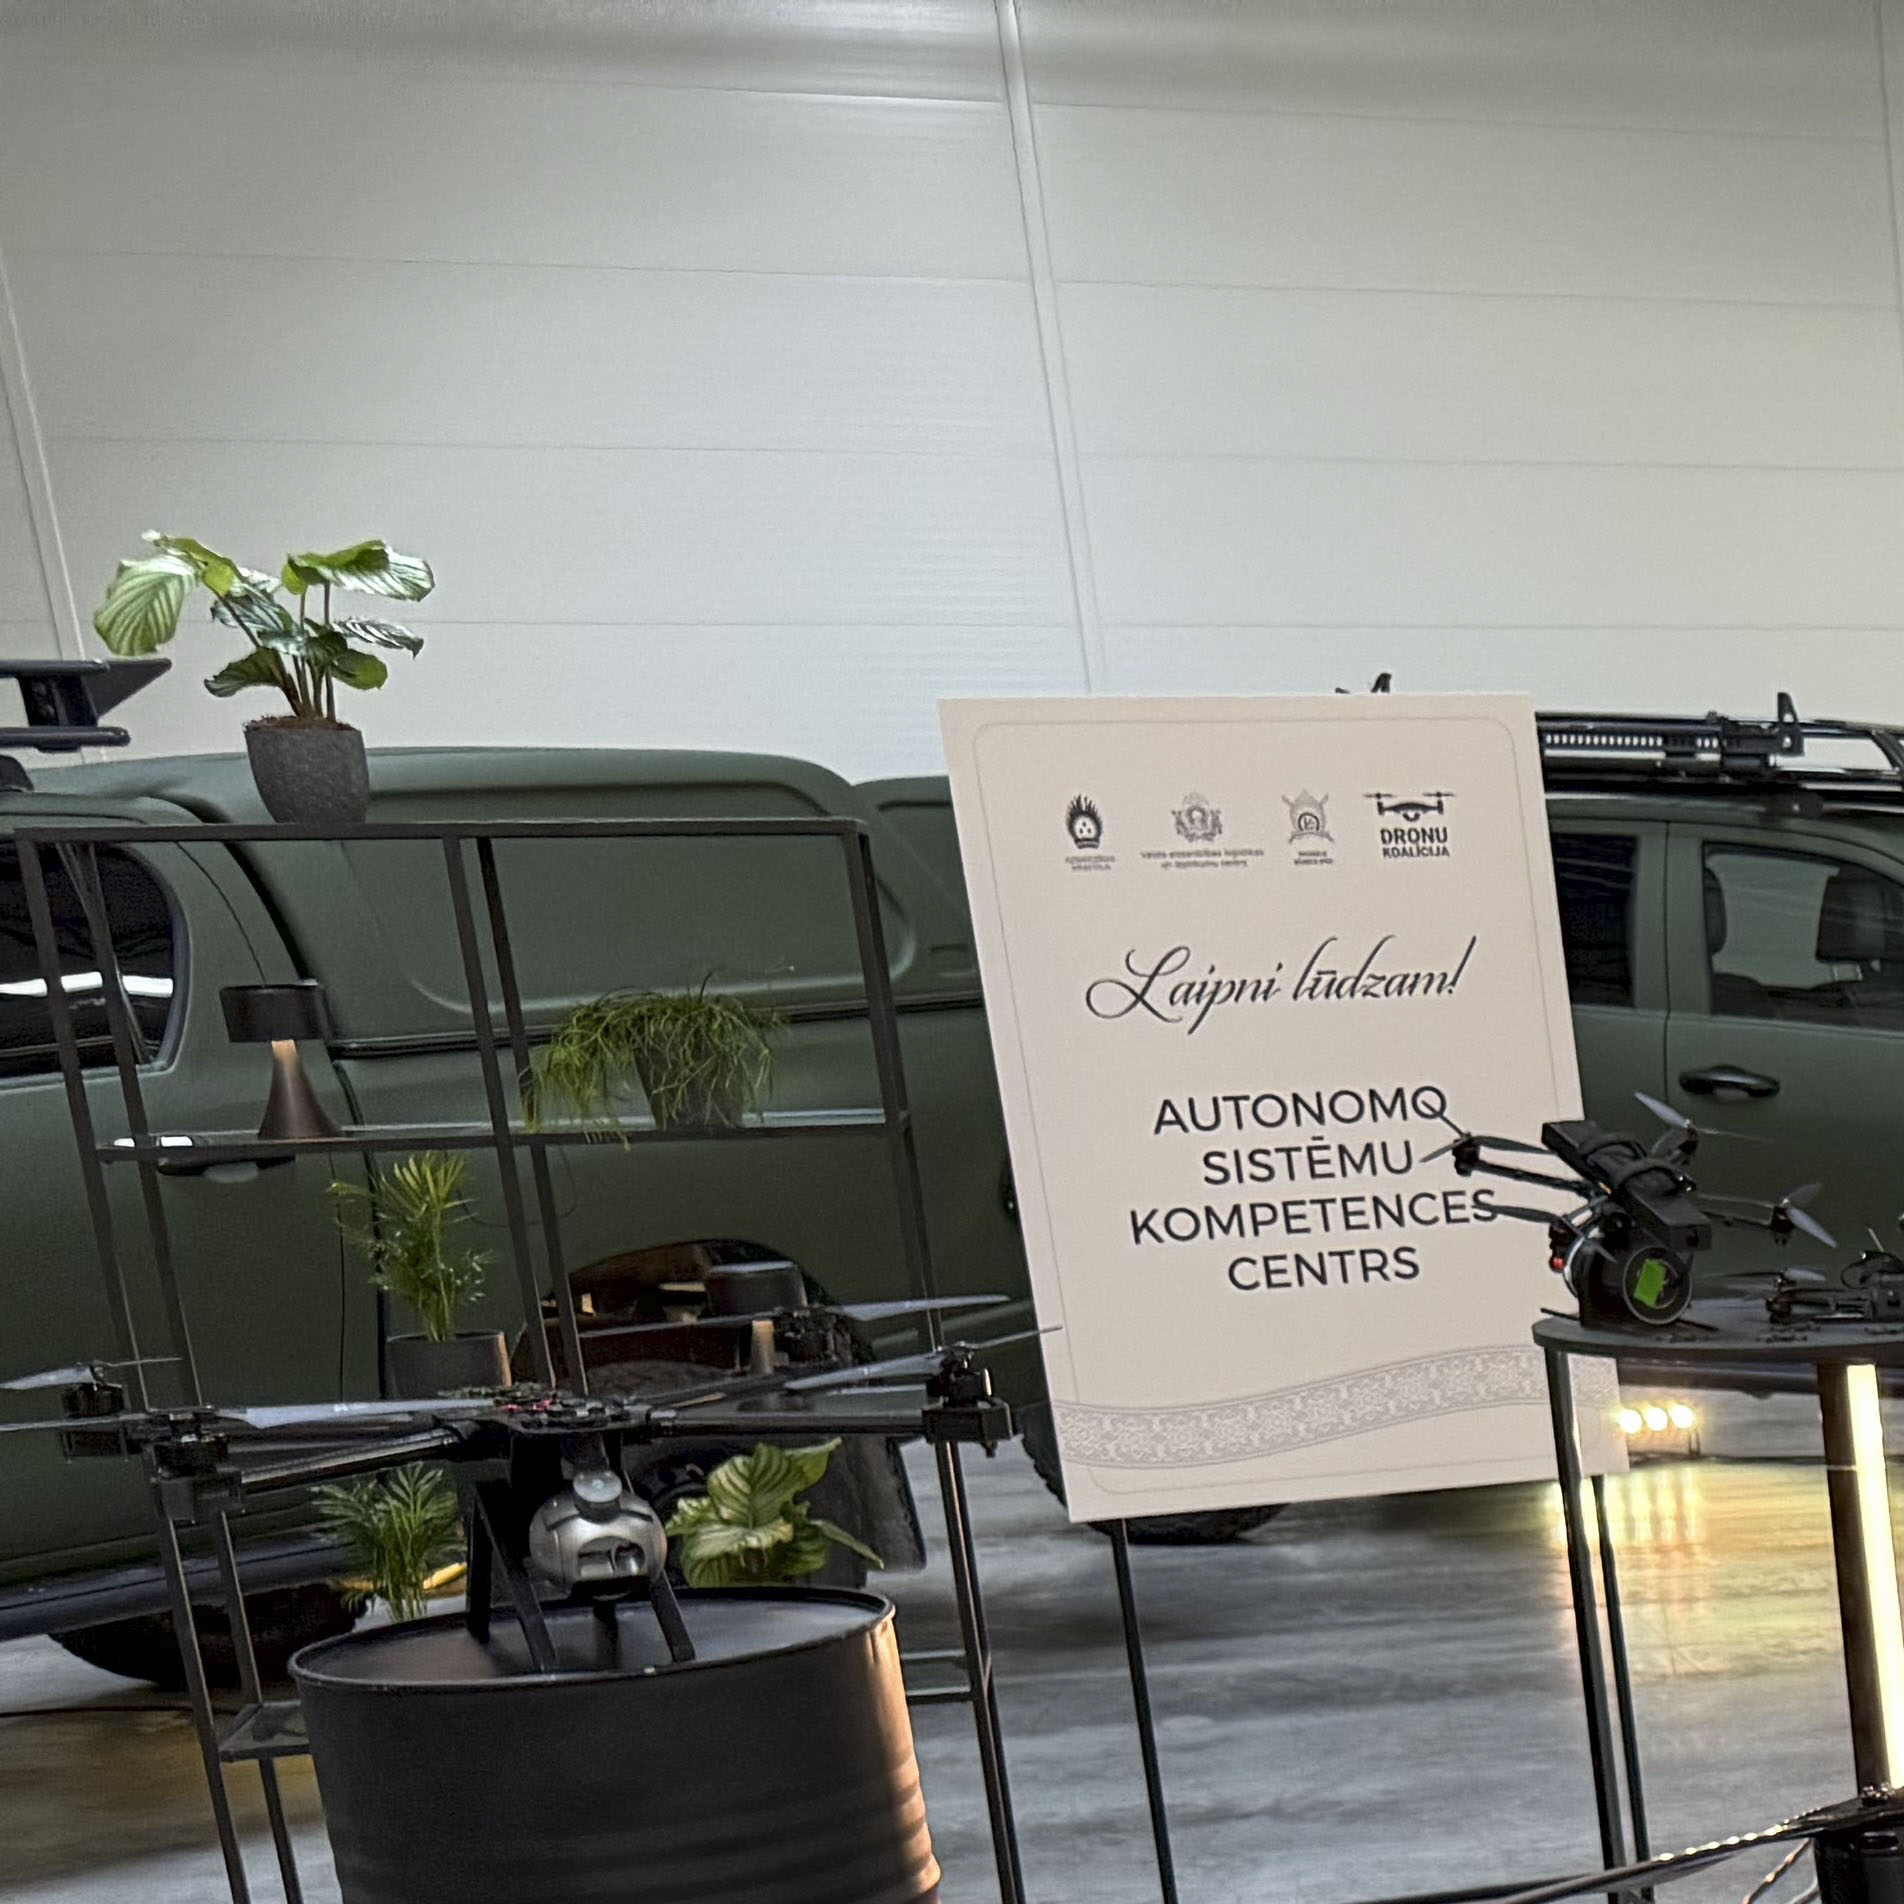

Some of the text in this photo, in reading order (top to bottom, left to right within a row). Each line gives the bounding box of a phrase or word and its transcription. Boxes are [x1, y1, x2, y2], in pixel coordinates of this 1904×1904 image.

[1379, 827, 1448, 845] DRONU
[1085, 934, 1477, 1036] Laipni lūdzam!
[1153, 1085, 1447, 1135] AUTONOMO
[1202, 1136, 1413, 1186] SISTĒMU
[1130, 1188, 1498, 1246] KOMPETENCES
[1227, 1246, 1420, 1291] CENTRS
